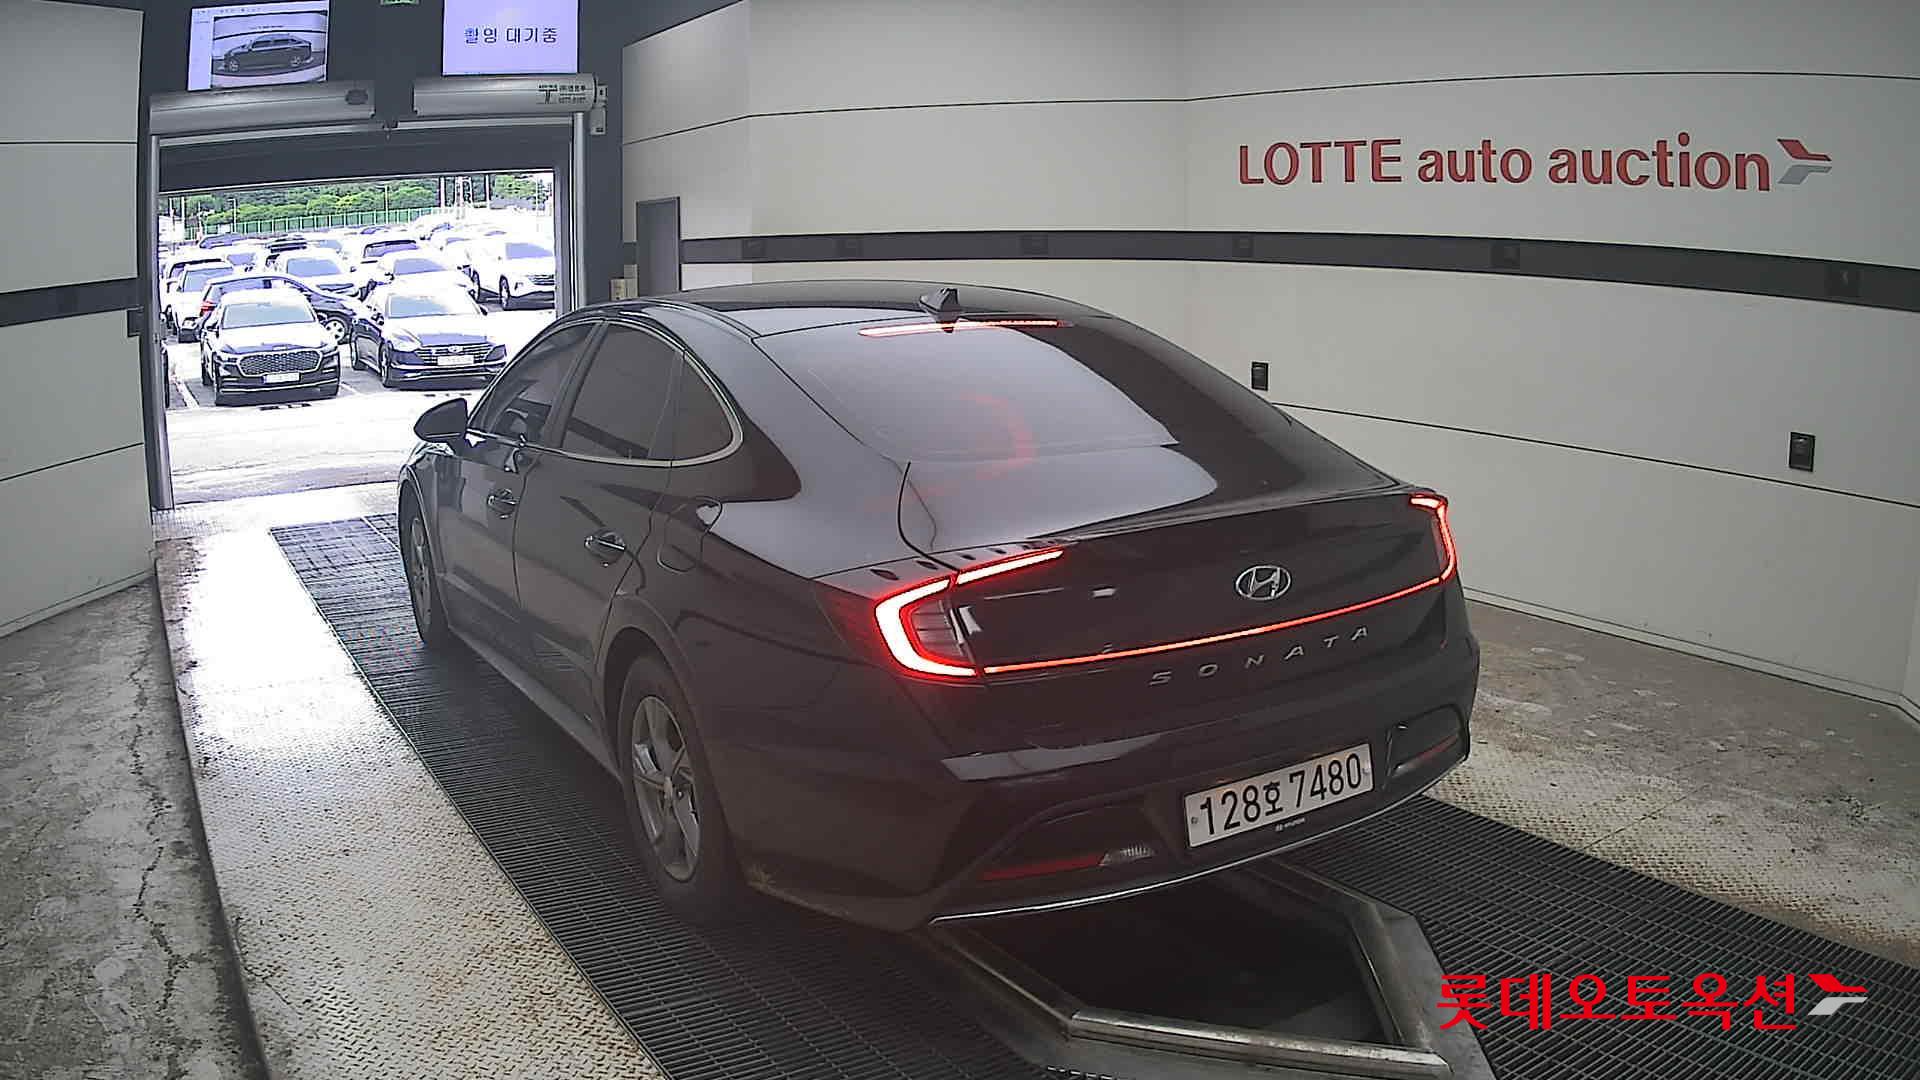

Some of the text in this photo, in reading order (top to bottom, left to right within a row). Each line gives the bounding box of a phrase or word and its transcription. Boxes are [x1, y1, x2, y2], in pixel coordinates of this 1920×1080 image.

[506, 27, 558, 44] 대기중
[1239, 132, 1771, 192] LOTTE auto auction
[1149, 626, 1369, 686] SONATA
[1288, 753, 1362, 808] 7480
